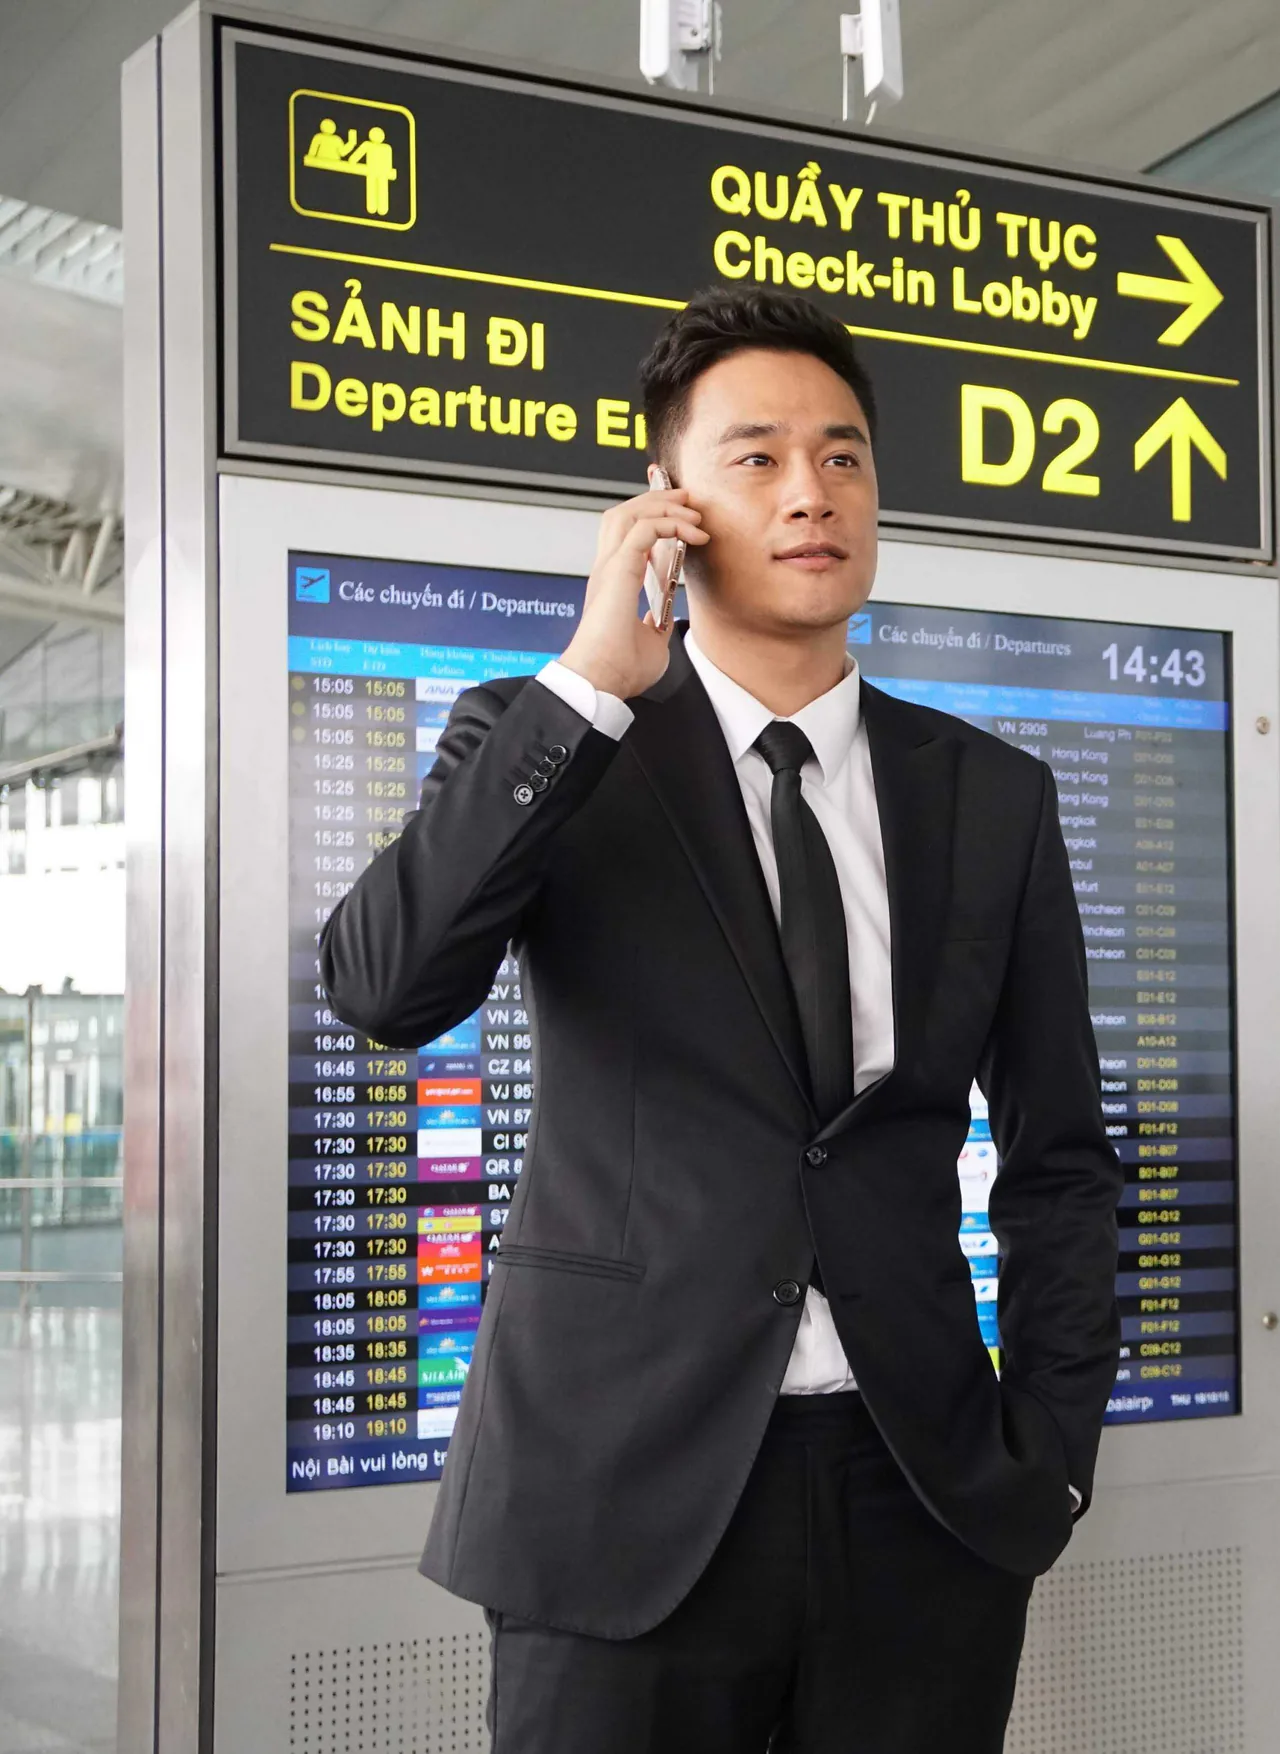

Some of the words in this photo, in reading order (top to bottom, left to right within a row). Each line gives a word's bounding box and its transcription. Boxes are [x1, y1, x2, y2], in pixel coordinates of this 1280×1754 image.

[710, 160, 863, 232] QUẦY
[877, 188, 982, 252] THỦ
[996, 212, 1098, 272] TỤC
[713, 231, 936, 308] Check-in
[952, 266, 1098, 340] Lobby
[290, 279, 466, 361] SẢNH
[486, 316, 546, 371] ĐI
[290, 360, 578, 443] Departure
[959, 383, 1101, 498] D2
[338, 580, 375, 603] Các
[447, 588, 465, 609] đi
[469, 591, 477, 610] /
[481, 592, 576, 618] Departures
[879, 624, 908, 642] Các
[967, 631, 981, 649] đi
[984, 632, 990, 649] /
[994, 633, 1071, 656] Departures
[1101, 642, 1207, 688] 14:43
[313, 677, 354, 695] 15:05
[313, 702, 354, 721] 15:05
[313, 727, 354, 745] 15:05
[997, 720, 1017, 735] VN
[314, 753, 354, 770] 15:25
[1051, 747, 1080, 763] Hong
[1081, 748, 1108, 764] Kong
[1081, 770, 1108, 786] Kong
[313, 779, 355, 796] 15:25
[1058, 792, 1080, 807] ong
[1081, 792, 1109, 808] Kong
[314, 805, 355, 821] 15:25
[314, 830, 355, 847] 15:25
[366, 832, 401, 848] 15:2
[314, 855, 355, 872] 15:25
[486, 1009, 509, 1025] VN
[314, 1034, 355, 1051] 16:40
[486, 1034, 509, 1050] VN
[314, 1060, 356, 1077] 16:45
[367, 1059, 407, 1076] 17:20
[487, 1059, 510, 1075] CZ
[513, 1058, 533, 1075] 84
[314, 1086, 356, 1103] 16:55
[367, 1085, 407, 1102] 16:55
[490, 1084, 510, 1100] VJ
[314, 1111, 355, 1129] 17:30
[367, 1110, 407, 1128] 17:30
[487, 1109, 510, 1125] VN
[314, 1137, 355, 1154] 17:30
[367, 1135, 407, 1153] 17:30
[314, 1163, 356, 1180] 17:30
[367, 1161, 407, 1178] 17:30
[485, 1158, 510, 1175] QR
[314, 1188, 355, 1206] 17:30
[367, 1187, 407, 1204] 17:30
[488, 1184, 511, 1200] BA
[314, 1214, 355, 1232] 17:30
[367, 1212, 407, 1230] 17:30
[314, 1240, 355, 1258] 17:30
[367, 1238, 407, 1255] 17:30
[314, 1266, 355, 1284] 17:55
[367, 1263, 407, 1281] 17:55
[314, 1292, 355, 1310] 18:05
[367, 1289, 407, 1307] 18:05
[314, 1318, 355, 1337] 18:05
[367, 1314, 407, 1333] 18:05
[314, 1343, 355, 1363] 18:35
[367, 1340, 407, 1359] 18:35
[314, 1369, 355, 1389] 18:45
[367, 1366, 407, 1385] 18:45
[313, 1395, 355, 1415] 18:45
[367, 1391, 407, 1411] 18:45
[314, 1421, 355, 1441] 19:10
[367, 1417, 407, 1437] 19:10
[292, 1457, 321, 1480] Nội
[327, 1455, 354, 1476] Bài
[360, 1453, 386, 1473] vui
[391, 1450, 428, 1472] lòng
